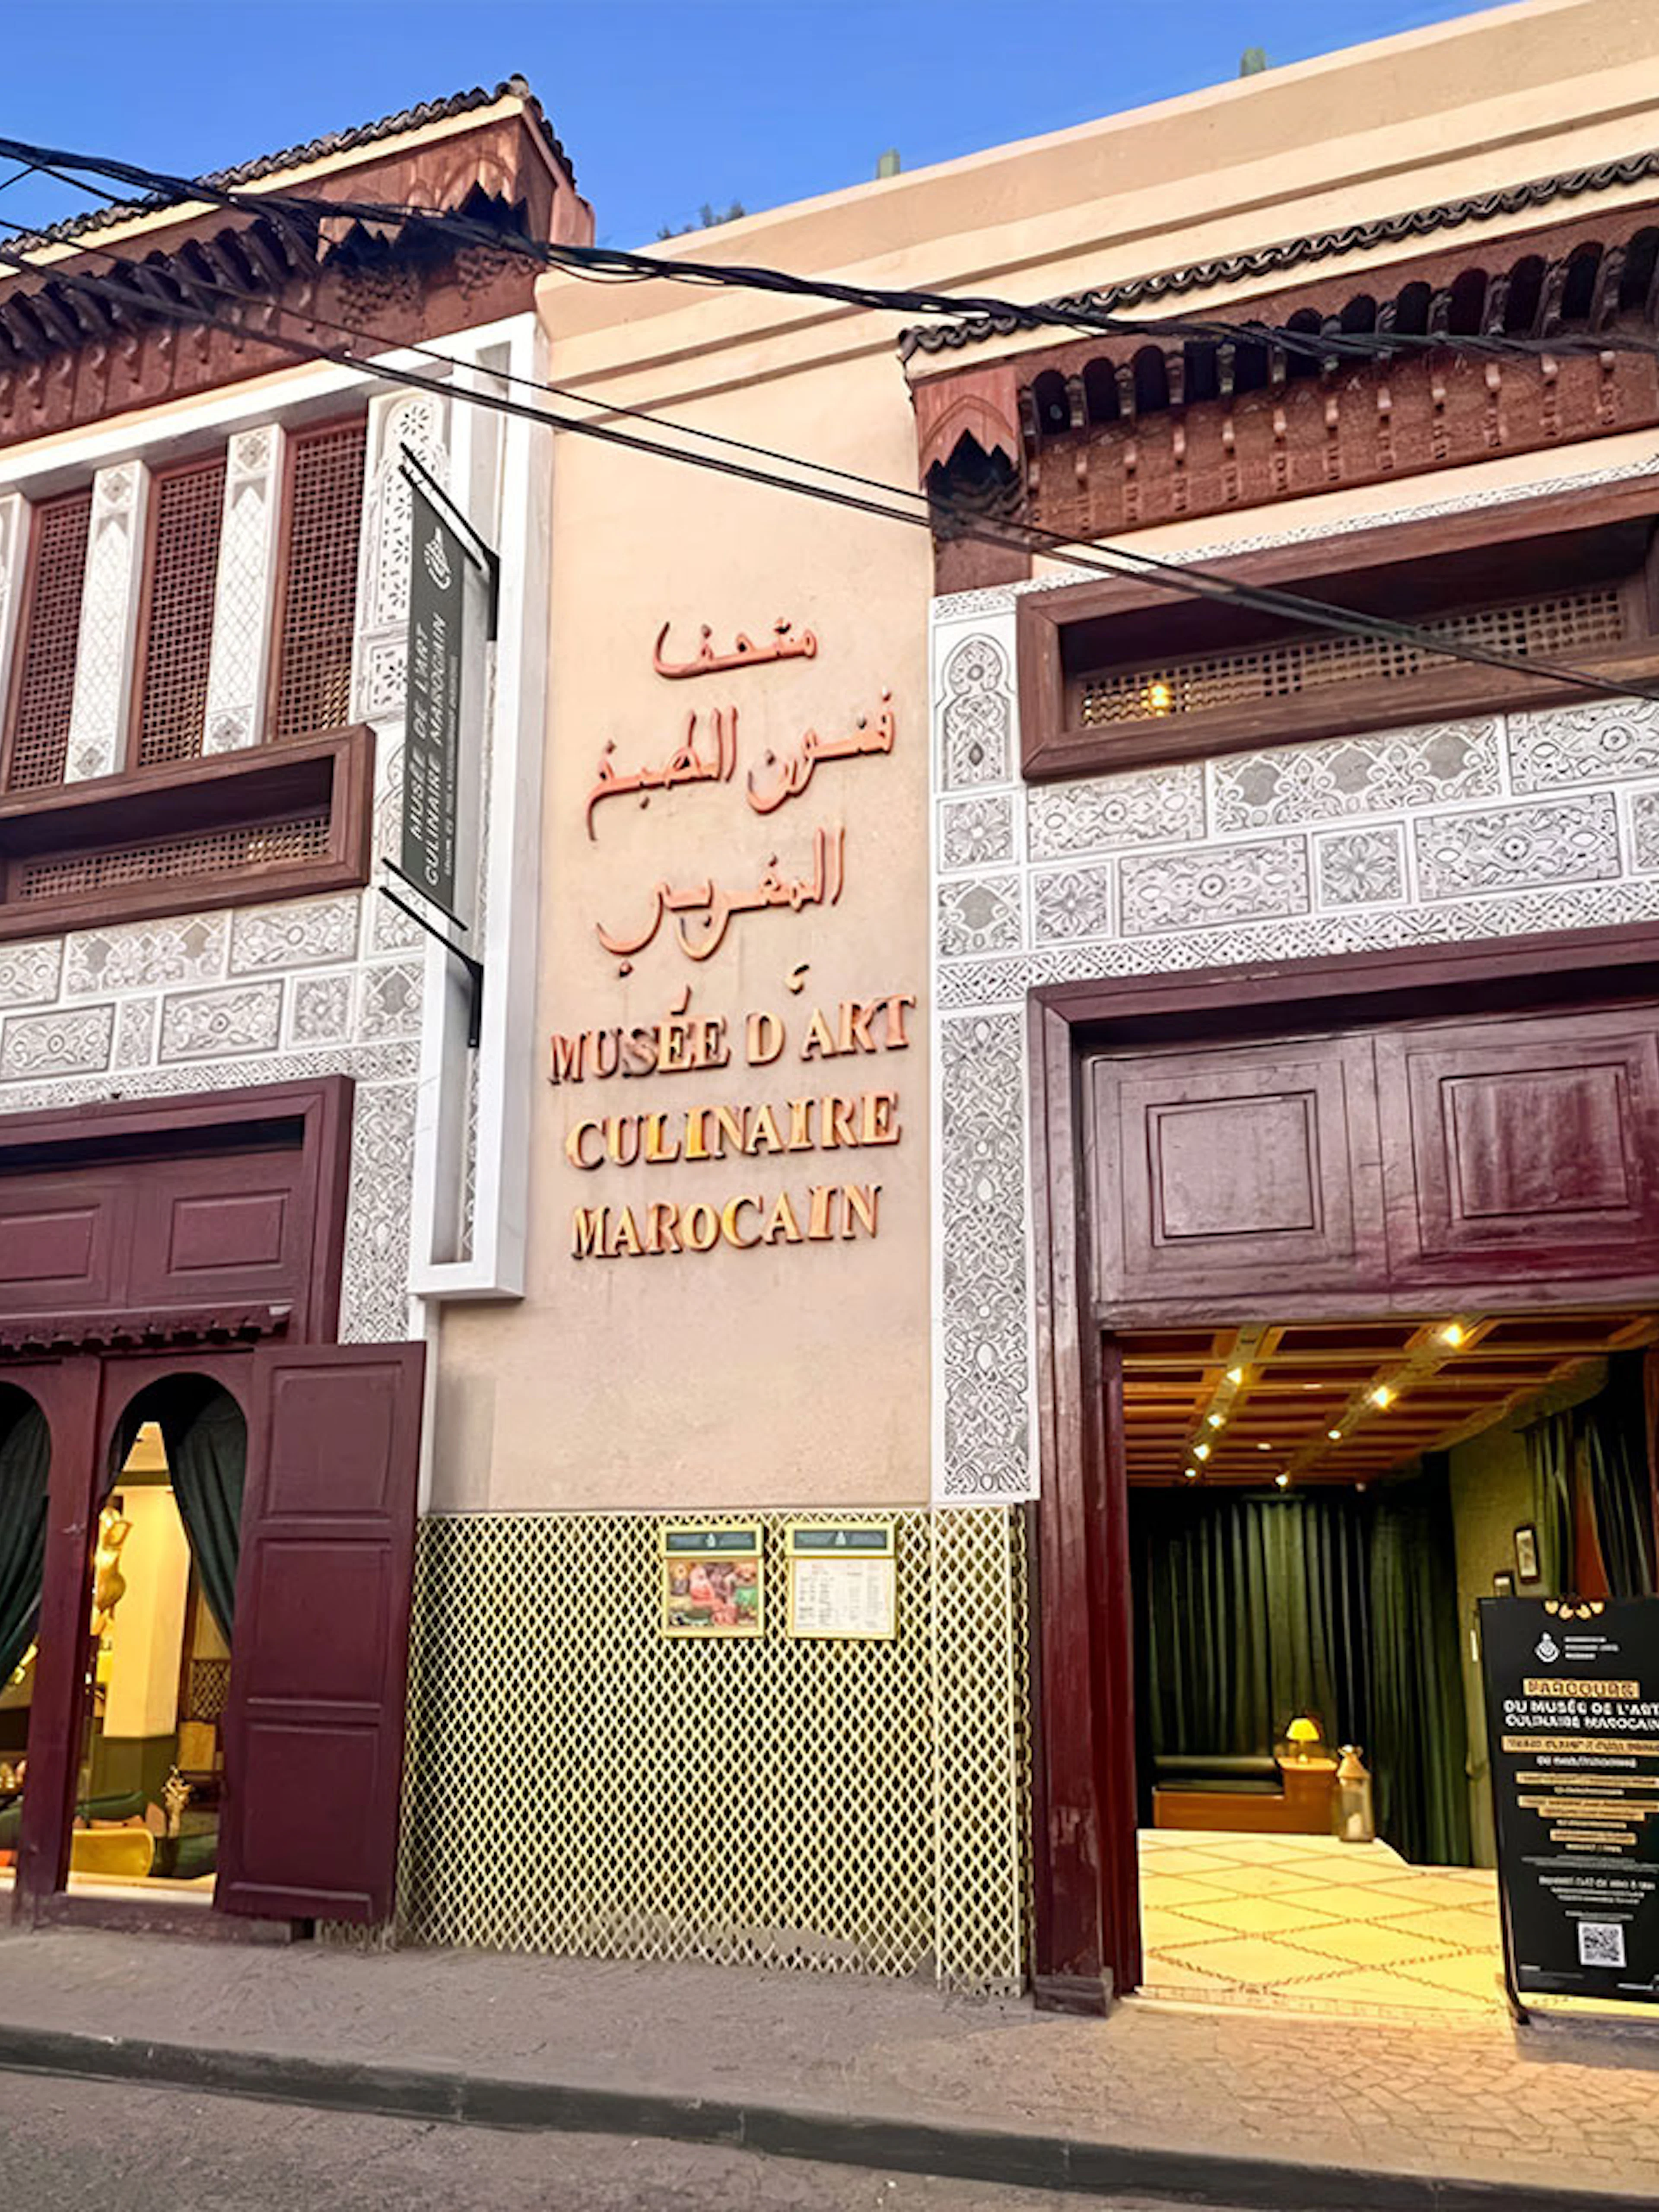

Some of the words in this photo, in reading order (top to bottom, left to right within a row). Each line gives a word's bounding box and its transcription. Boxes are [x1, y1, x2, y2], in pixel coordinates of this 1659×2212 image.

[653, 617, 817, 679] متحف
[585, 704, 738, 841] الطبخ
[747, 689, 895, 815] فنون
[549, 984, 731, 1085] MUSÉE
[565, 1089, 902, 1170] CULINAIRE
[571, 1184, 882, 1260] MAROCAIN
